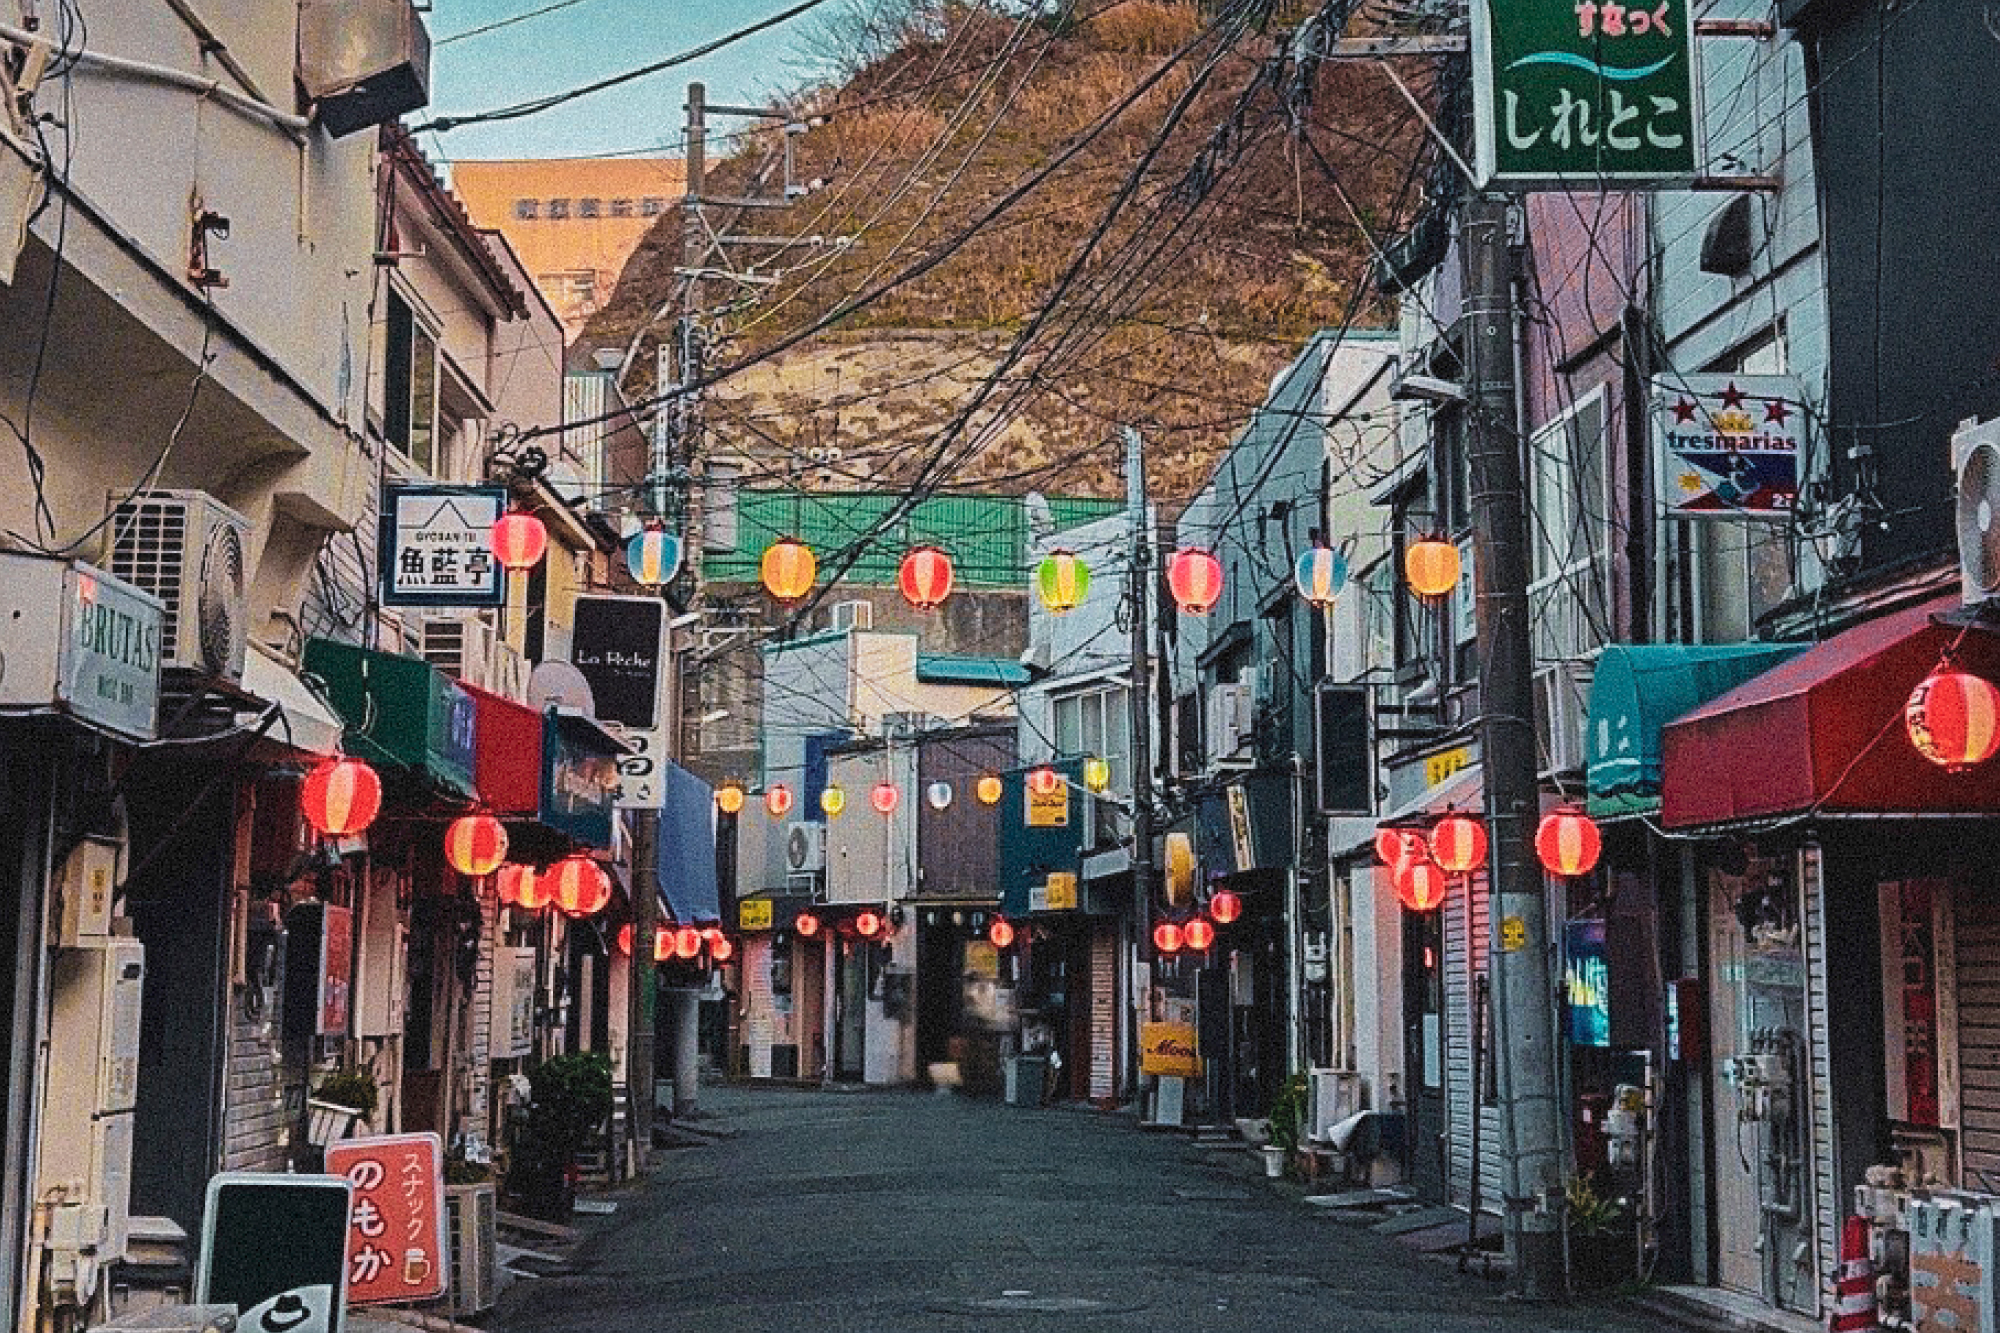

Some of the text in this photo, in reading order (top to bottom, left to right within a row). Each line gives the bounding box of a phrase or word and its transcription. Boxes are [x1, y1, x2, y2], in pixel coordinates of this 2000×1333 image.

[1503, 88, 1683, 149] しれとこ
[398, 546, 492, 586] 魚藍亭
[82, 602, 153, 673] BRUTAS
[350, 1159, 393, 1284] のもか
[402, 1154, 424, 1241] スナック
